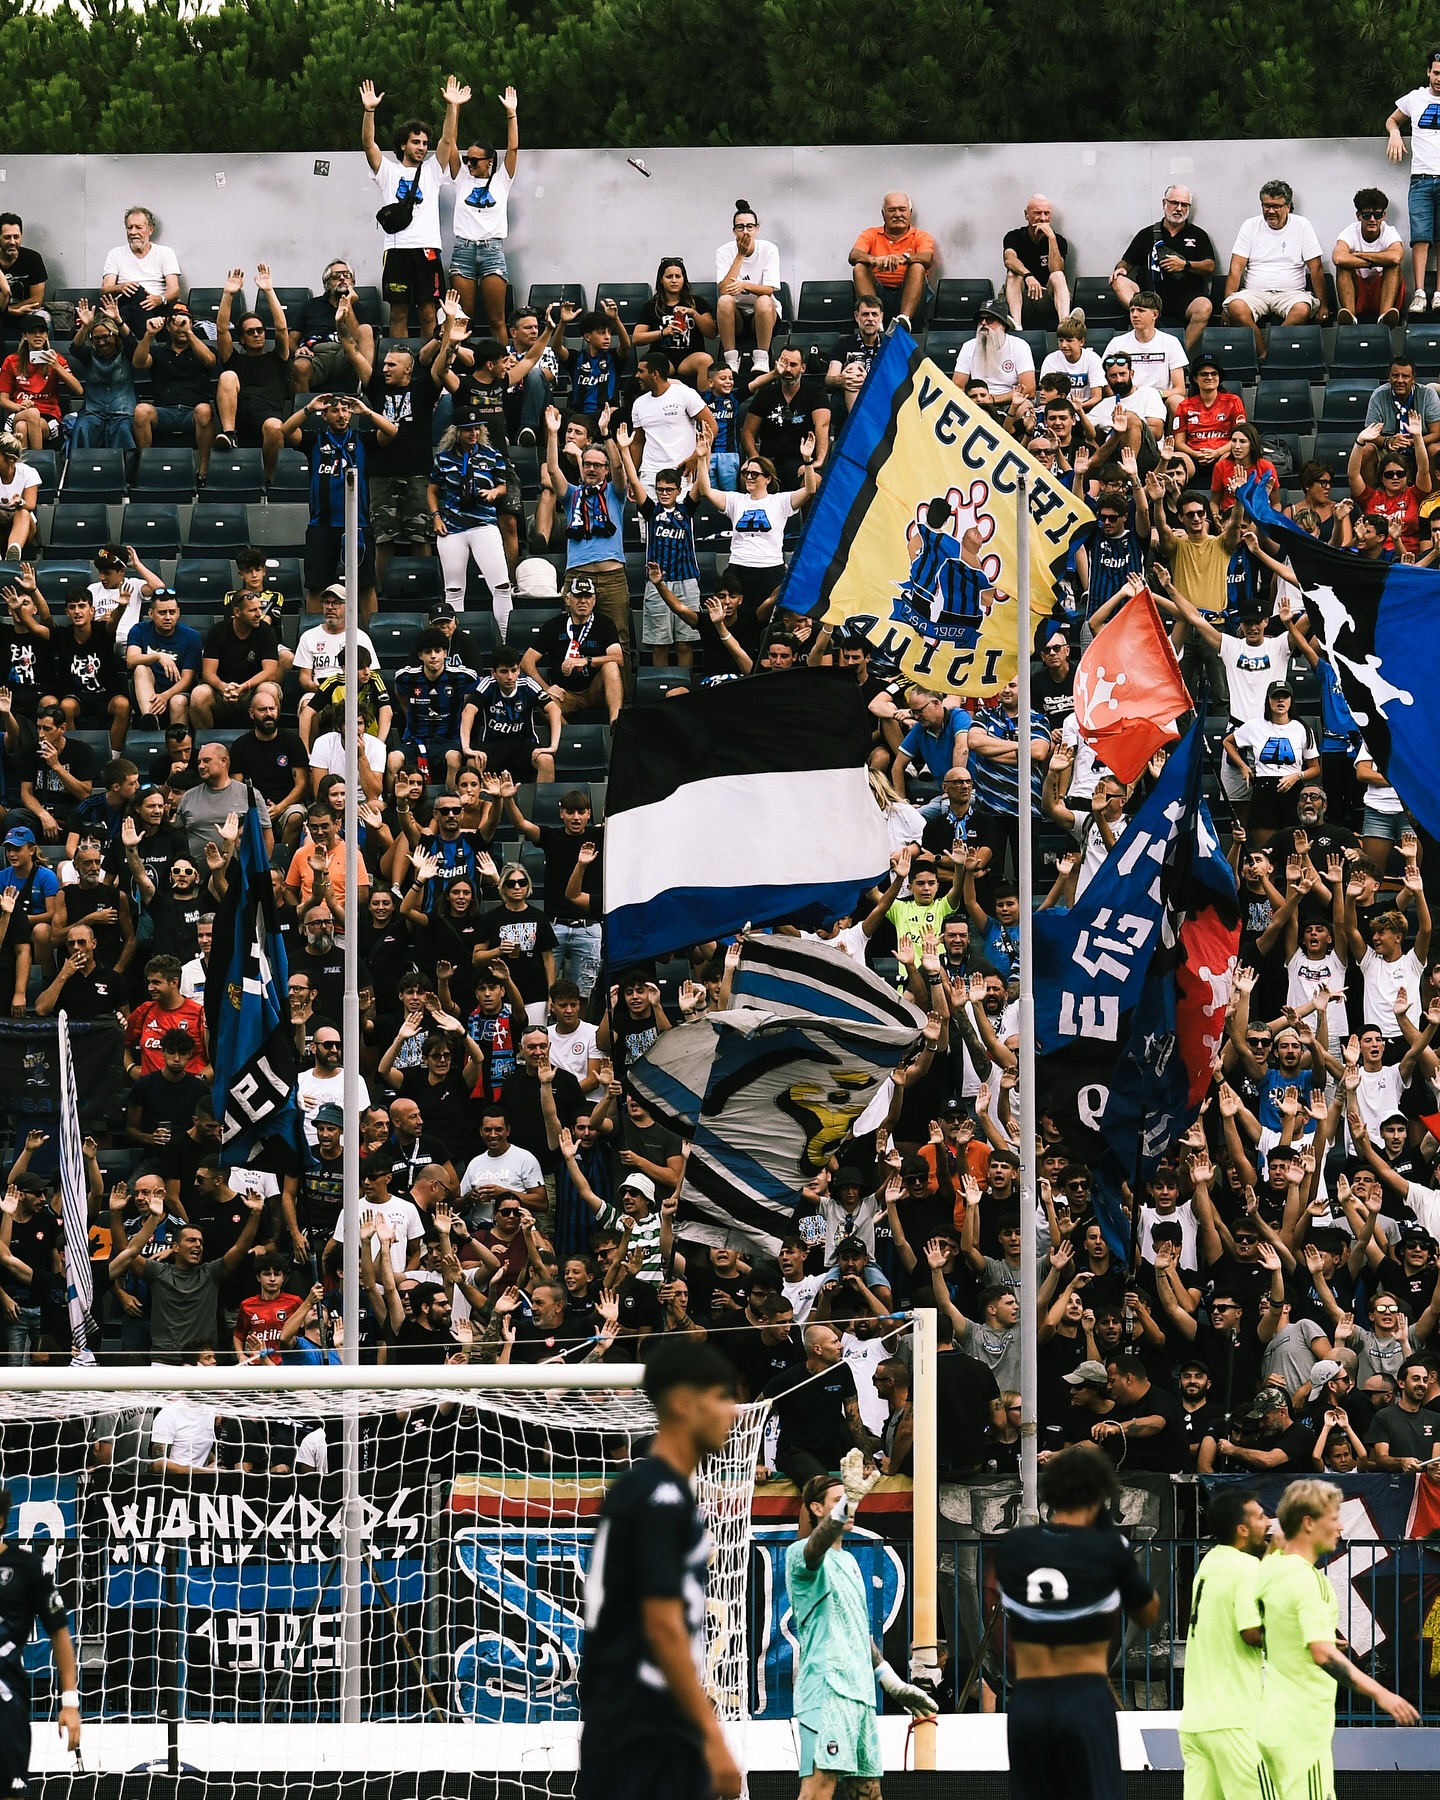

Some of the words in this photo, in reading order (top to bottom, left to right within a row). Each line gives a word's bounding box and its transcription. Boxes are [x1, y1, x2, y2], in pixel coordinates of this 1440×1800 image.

[916, 375, 1079, 545] VECCHI
[933, 626, 966, 638] 1909
[195, 1614, 342, 1668] 1975
